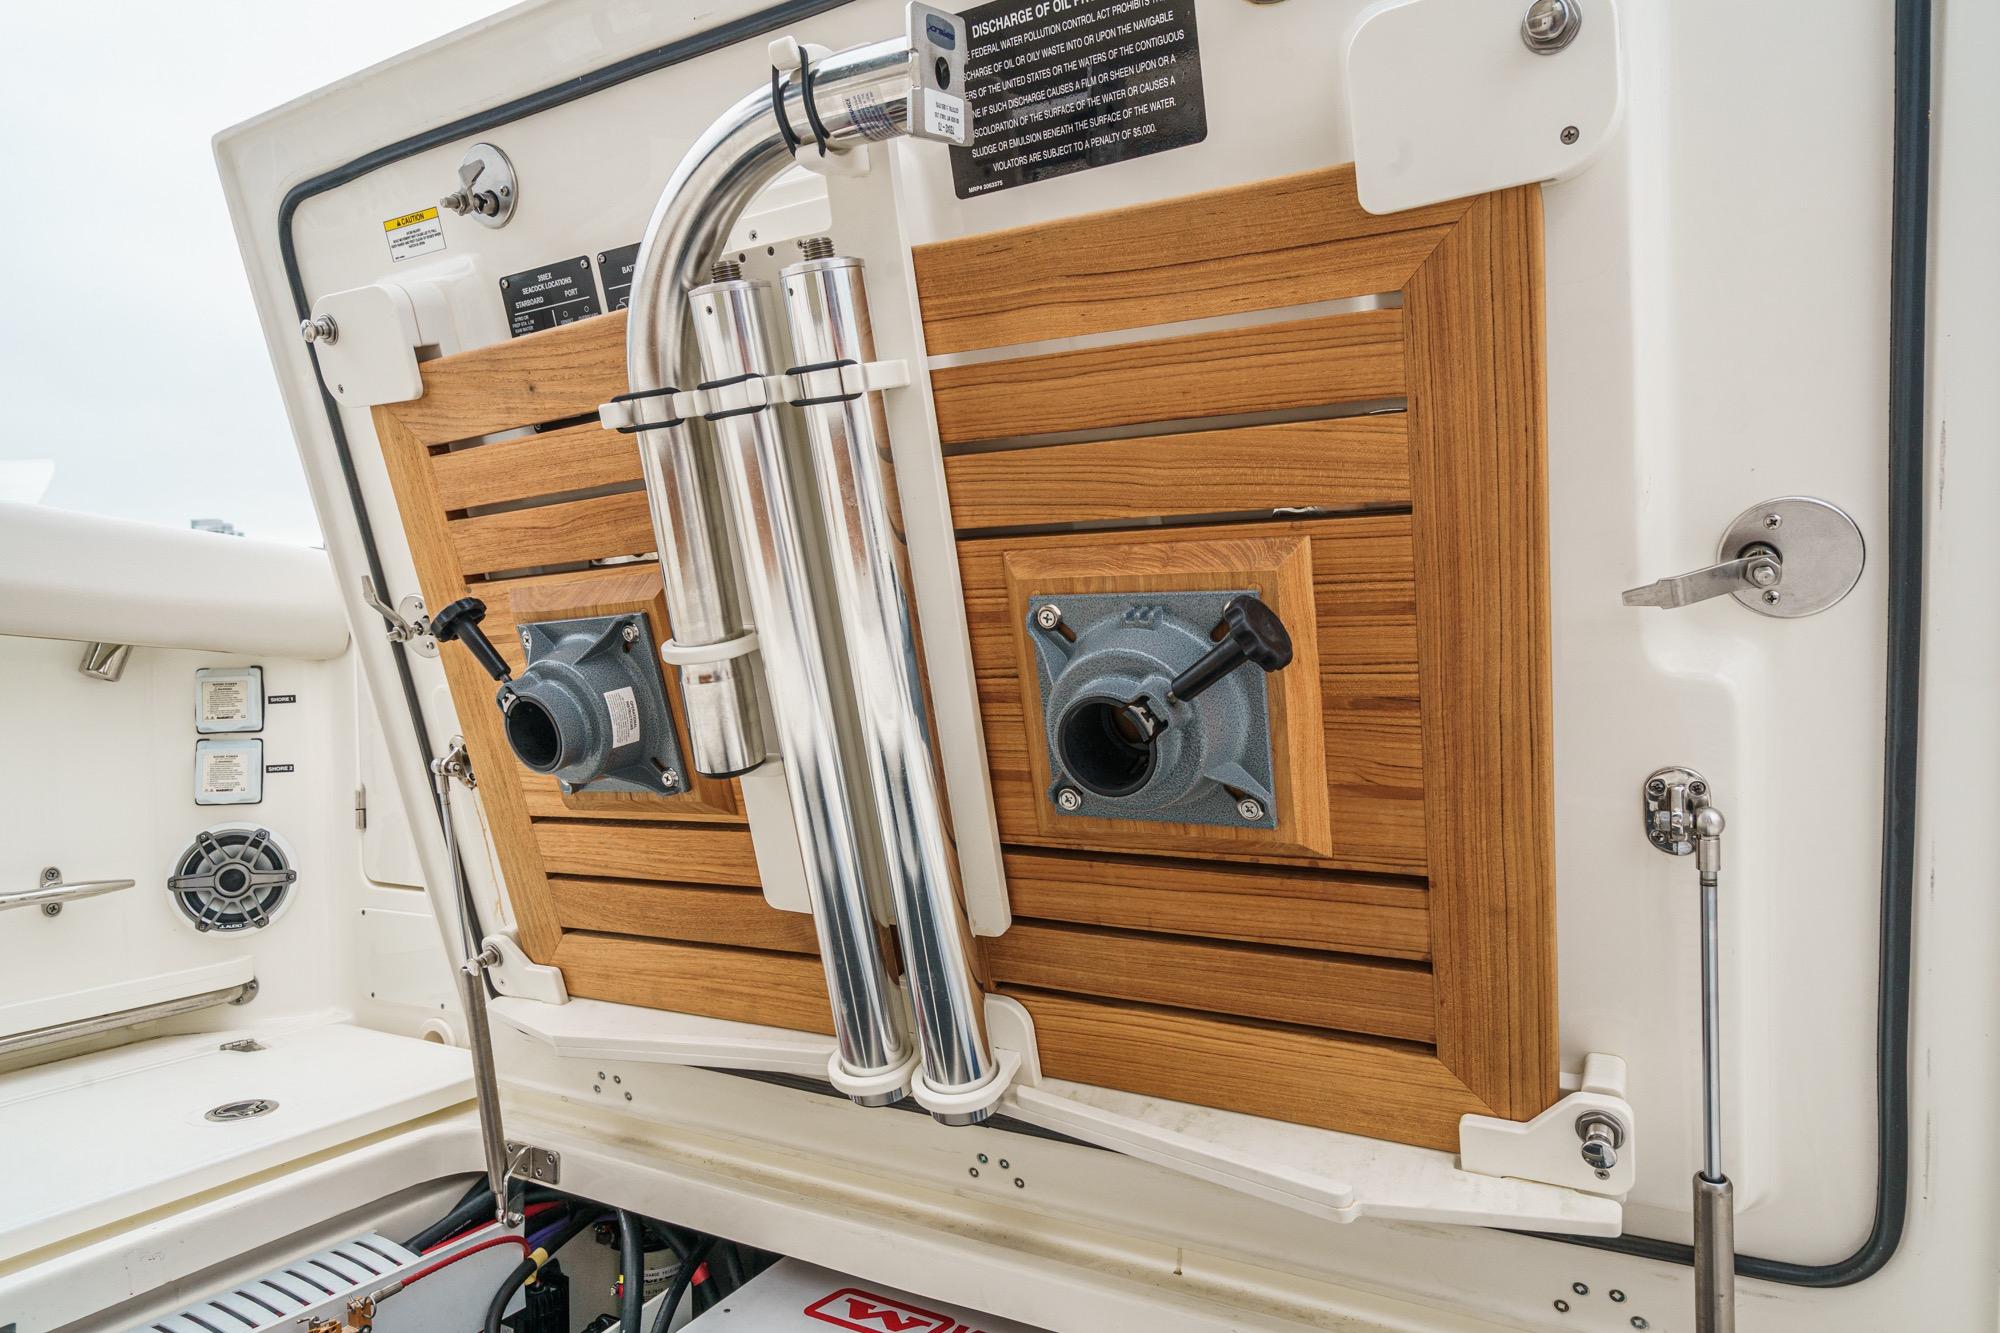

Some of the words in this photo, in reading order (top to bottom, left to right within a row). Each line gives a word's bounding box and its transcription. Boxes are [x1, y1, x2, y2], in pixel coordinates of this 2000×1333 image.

[971, 43, 999, 59] FEDERAL
[1001, 36, 1024, 50] WATER
[1024, 24, 1060, 43] POLLUTION
[1062, 13, 1096, 31] CONTROL
[1096, 9, 1109, 20] ACT
[972, 7, 1033, 38] DISCHARGE
[1035, 1, 1049, 18] OF
[993, 62, 1002, 72] OF
[1003, 58, 1014, 69] OIL
[1015, 55, 1025, 66] OR
[1026, 51, 1040, 62] OILY
[1042, 44, 1064, 58] WASTE
[1066, 38, 1083, 50] INTO
[1084, 35, 1094, 45] OR
[1095, 28, 1116, 42] UPON
[1118, 24, 1131, 35] THE
[1133, 11, 1173, 31] NAVIGABLE
[978, 87, 986, 97] OF
[989, 83, 1000, 94] THE
[1002, 76, 1025, 90] UNITED
[1026, 68, 1052, 83] STATES
[1053, 65, 1062, 76] OR
[1064, 61, 1076, 72] THE
[1078, 52, 1107, 68] WATERS
[1108, 49, 1118, 60] OF
[1120, 45, 1133, 56] THE
[1135, 30, 1184, 52] CONTIGUOUS
[982, 107, 987, 116] IF
[988, 101, 1008, 114] SUCH
[1008, 90, 1045, 108] DISCHARGE
[1046, 82, 1073, 98] CAUSES
[1075, 81, 1080, 90] A
[1081, 76, 1096, 88] FILM
[1098, 73, 1108, 83] OR
[1110, 66, 1134, 80] SHEEN
[1135, 59, 1156, 73] UPON
[1157, 56, 1169, 67] OR
[1170, 54, 1176, 63] A
[1019, 115, 1028, 125] OF
[1030, 112, 1042, 122] THE
[1044, 103, 1075, 119] SURFACE
[1075, 100, 1085, 110] OF
[1088, 96, 1100, 107] THE
[1101, 89, 1126, 103] WATER
[1127, 86, 1138, 96] OR
[1139, 78, 1168, 93] CAUSES
[1170, 76, 1175, 85] A
[971, 143, 997, 158] SLUDGE
[998, 140, 1008, 151] OR
[1008, 132, 1041, 148] EMULSION
[1043, 123, 1073, 139] BENEATH
[1075, 120, 1088, 131] THE
[1089, 111, 1121, 127] SURFACE
[1122, 108, 1132, 118] OF
[1135, 104, 1148, 115] THE
[1149, 97, 1176, 112] WATER.
[993, 155, 1027, 171] VIOLATORS
[1028, 151, 1041, 162] ARE
[1042, 144, 1072, 159] SUBJECT
[1074, 141, 1084, 151] TO
[1084, 139, 1089, 148] A
[1090, 132, 1120, 147] PENALTY
[1121, 129, 1131, 139] OF
[1132, 123, 1156, 136] $5,000.
[402, 213, 424, 225] CAUTION
[515, 296, 544, 308] STARBOARD
[522, 284, 545, 294] SEACOCK
[544, 277, 572, 290] LOCATIONS
[564, 288, 578, 298] PORT
